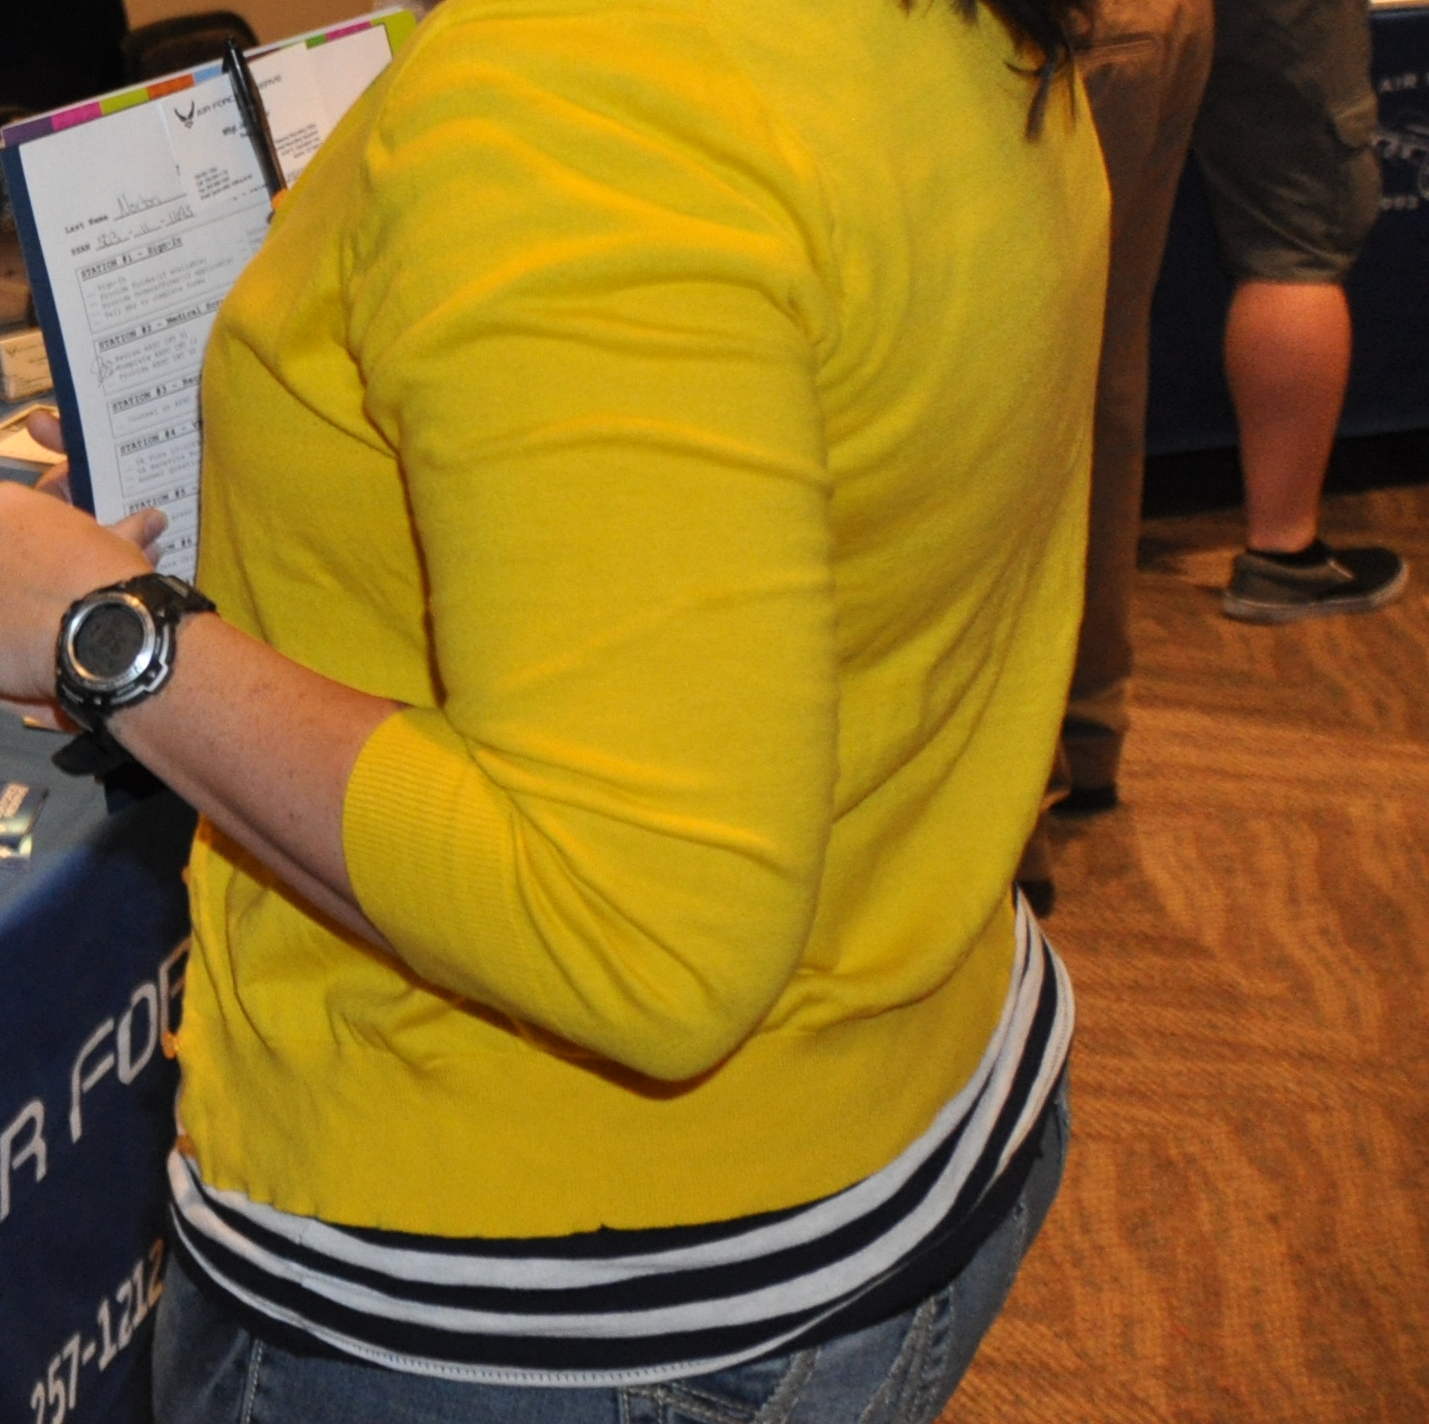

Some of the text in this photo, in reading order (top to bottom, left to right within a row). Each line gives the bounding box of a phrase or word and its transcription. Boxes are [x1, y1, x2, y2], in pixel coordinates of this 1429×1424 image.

[65, 222, 85, 234] Last
[81, 260, 118, 279] STATION
[98, 329, 137, 351] STATION
[166, 306, 202, 324] Medical
[112, 392, 152, 413] STATION
[120, 434, 160, 455] STATION
[129, 494, 169, 513] STATION
[69, 936, 192, 1144] FOR
